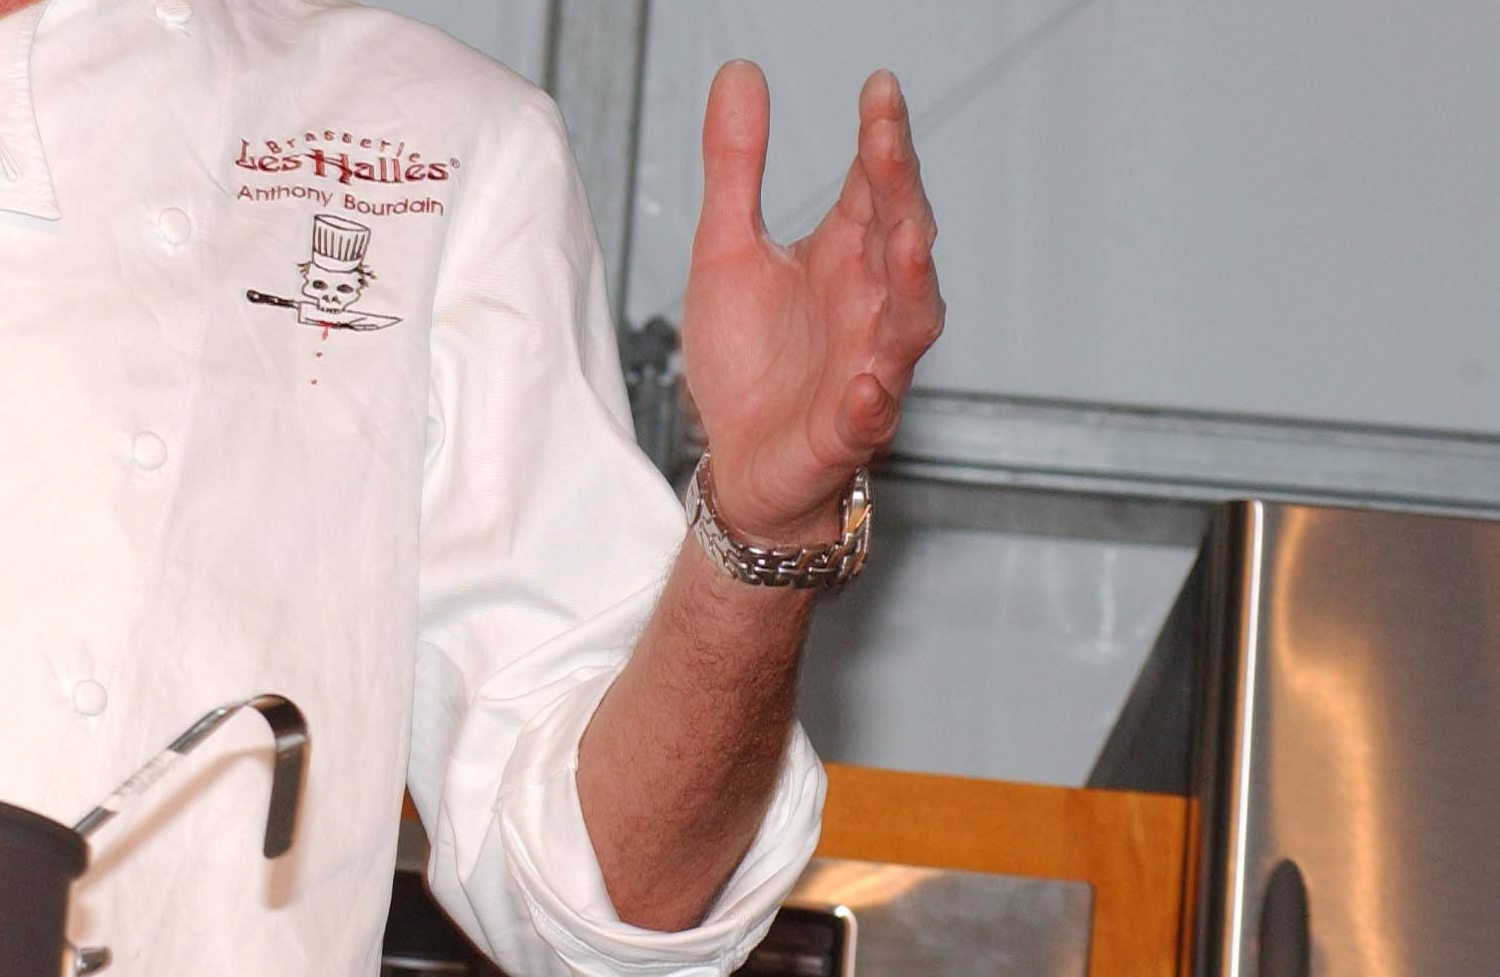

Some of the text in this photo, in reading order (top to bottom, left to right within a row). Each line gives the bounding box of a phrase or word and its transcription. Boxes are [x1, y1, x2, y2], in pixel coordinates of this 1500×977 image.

[235, 138, 302, 172] Les
[265, 130, 421, 163] Brasserie
[237, 185, 444, 216] Anthony Bourdain
